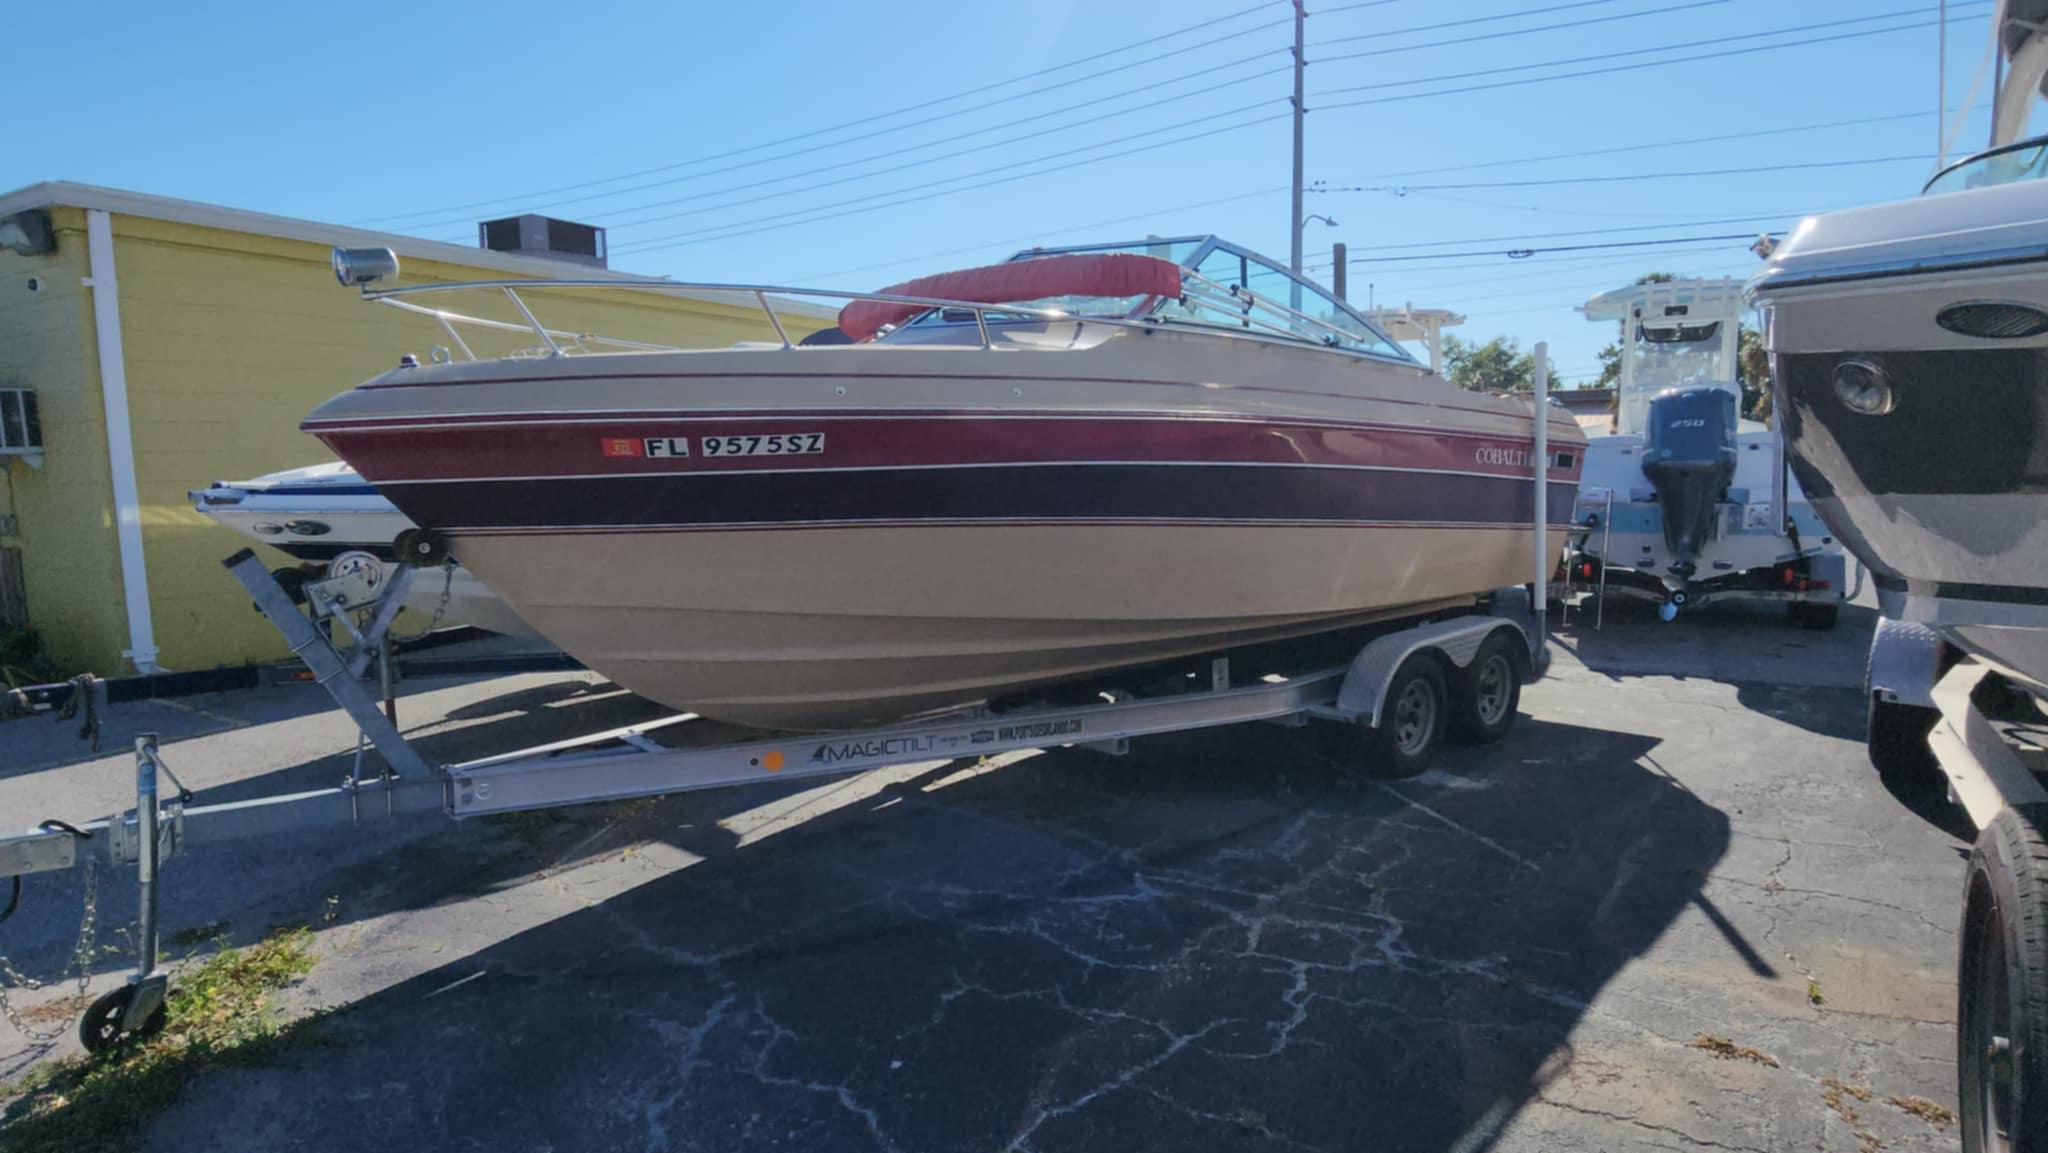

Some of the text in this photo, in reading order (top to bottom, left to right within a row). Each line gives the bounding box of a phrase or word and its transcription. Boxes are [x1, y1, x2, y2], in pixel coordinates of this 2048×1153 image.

[1670, 418, 1705, 429] 250
[647, 439, 686, 456] FL
[704, 434, 822, 454] 9575SZ
[1475, 447, 1522, 467] COBALT
[828, 735, 937, 761] MAGICTILT
